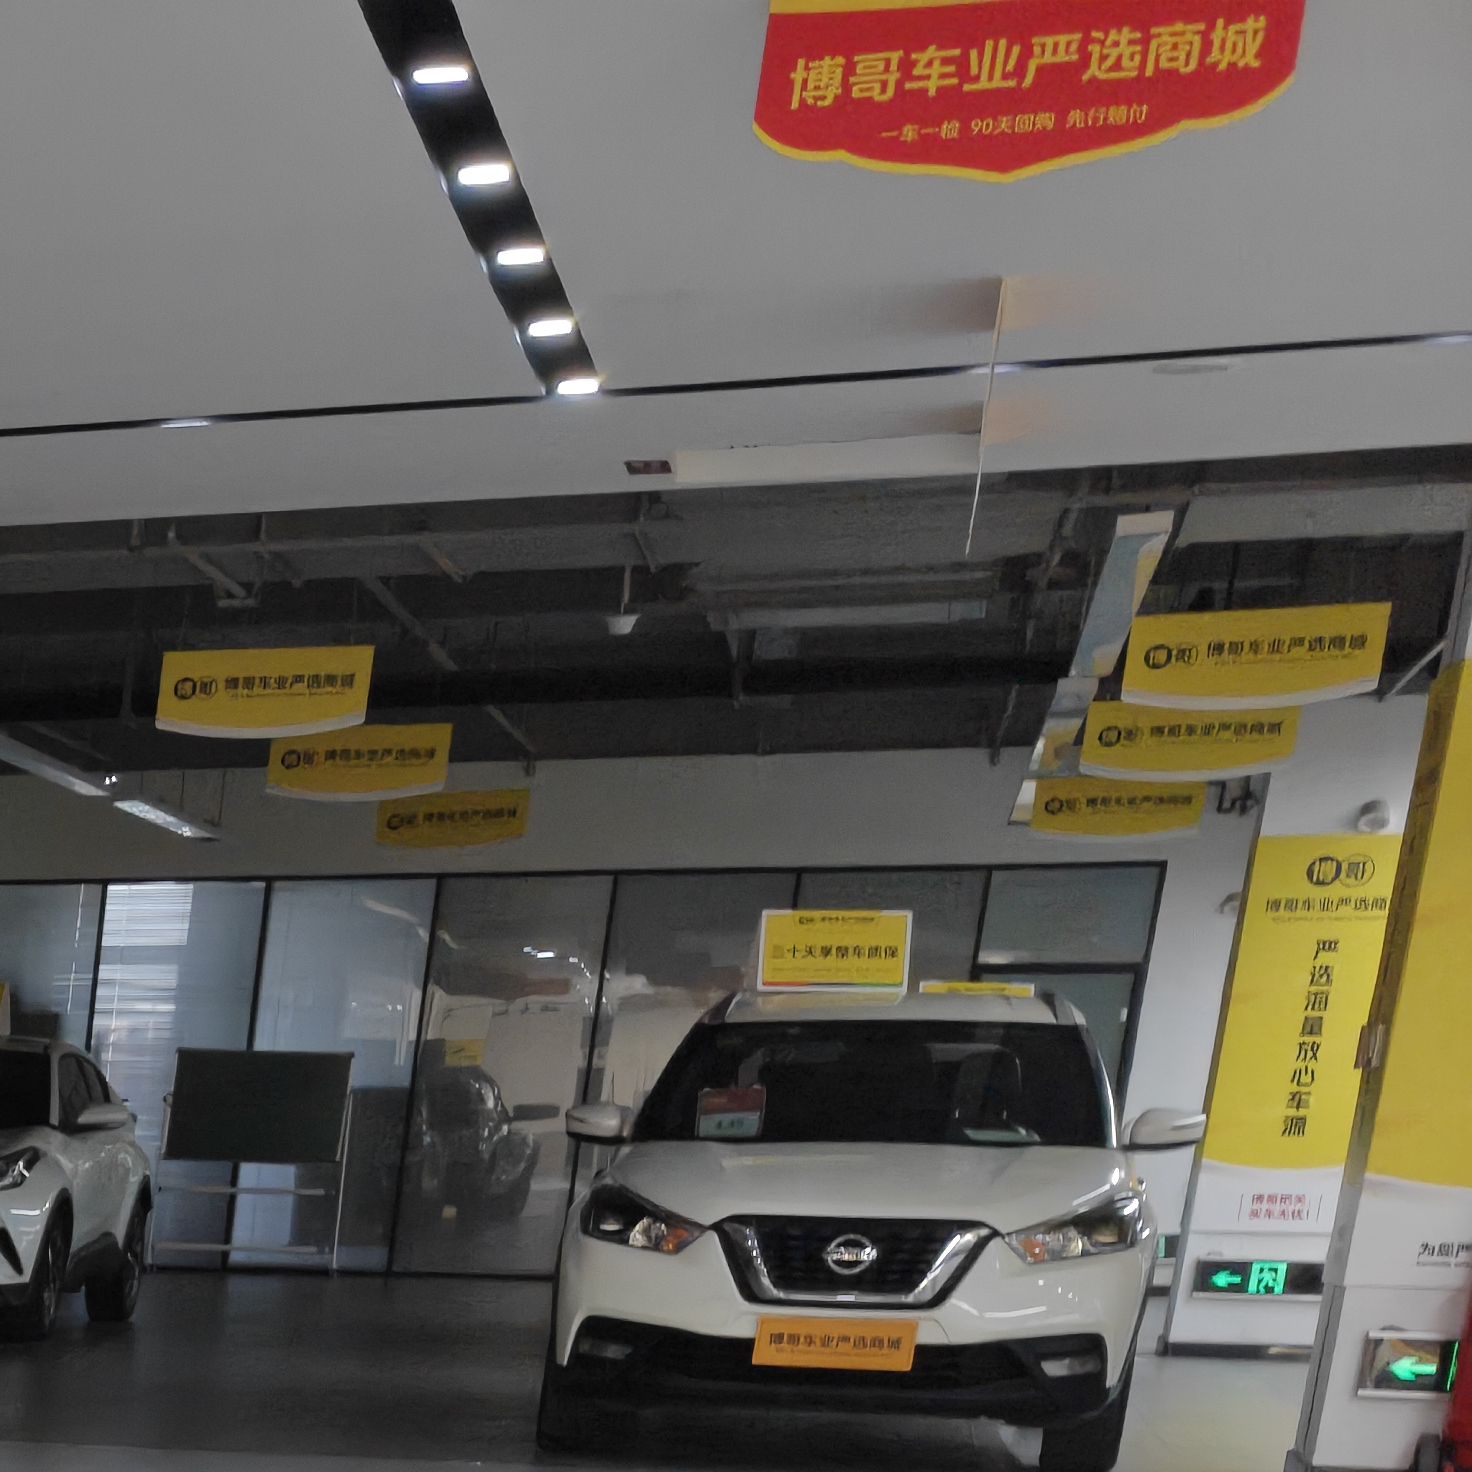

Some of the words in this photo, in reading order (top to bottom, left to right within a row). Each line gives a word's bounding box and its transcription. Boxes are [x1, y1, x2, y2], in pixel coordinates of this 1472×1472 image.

[789, 15, 1268, 110] 博哥车业严选商城
